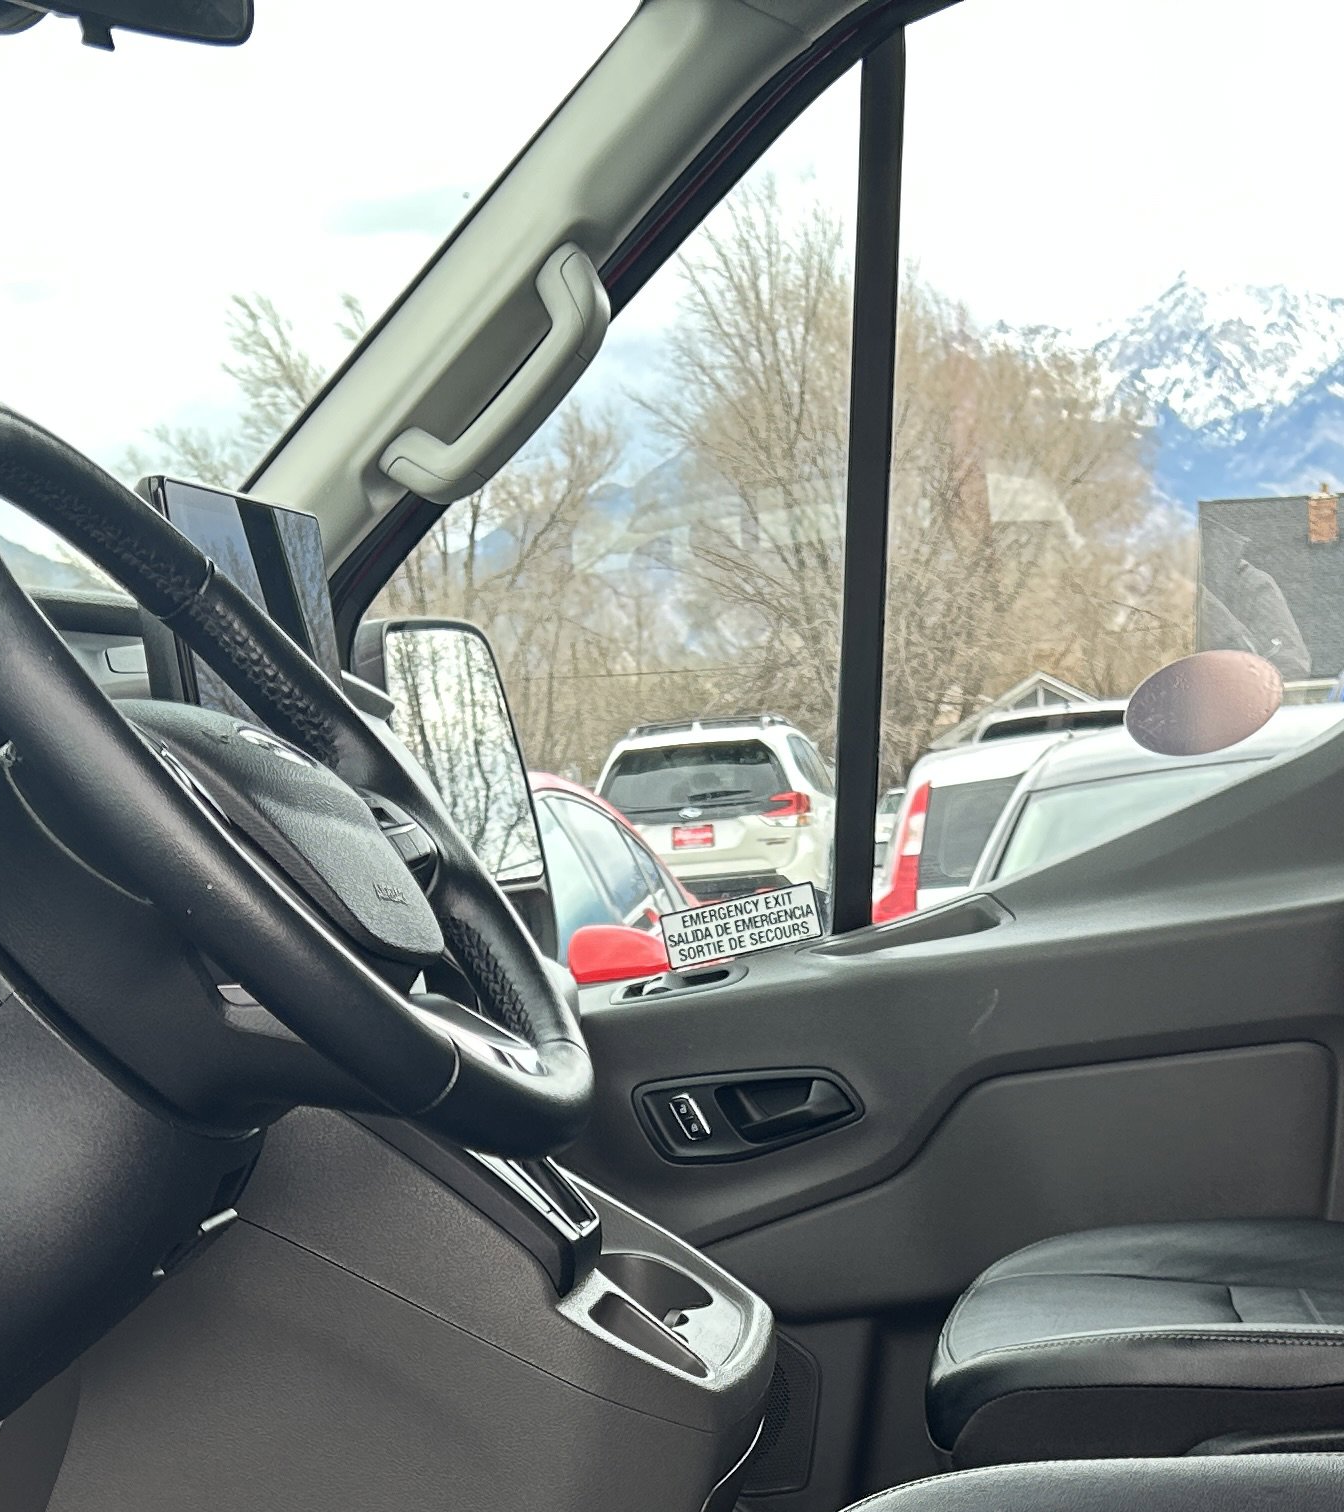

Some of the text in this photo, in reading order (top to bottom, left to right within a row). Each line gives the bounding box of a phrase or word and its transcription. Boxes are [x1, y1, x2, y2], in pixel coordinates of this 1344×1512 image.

[668, 903, 814, 948] SALIDA DE EMERGENCIA
[682, 891, 793, 929] EMERGENCY EXIT
[678, 921, 810, 962] SORTIE DE SECOURS
